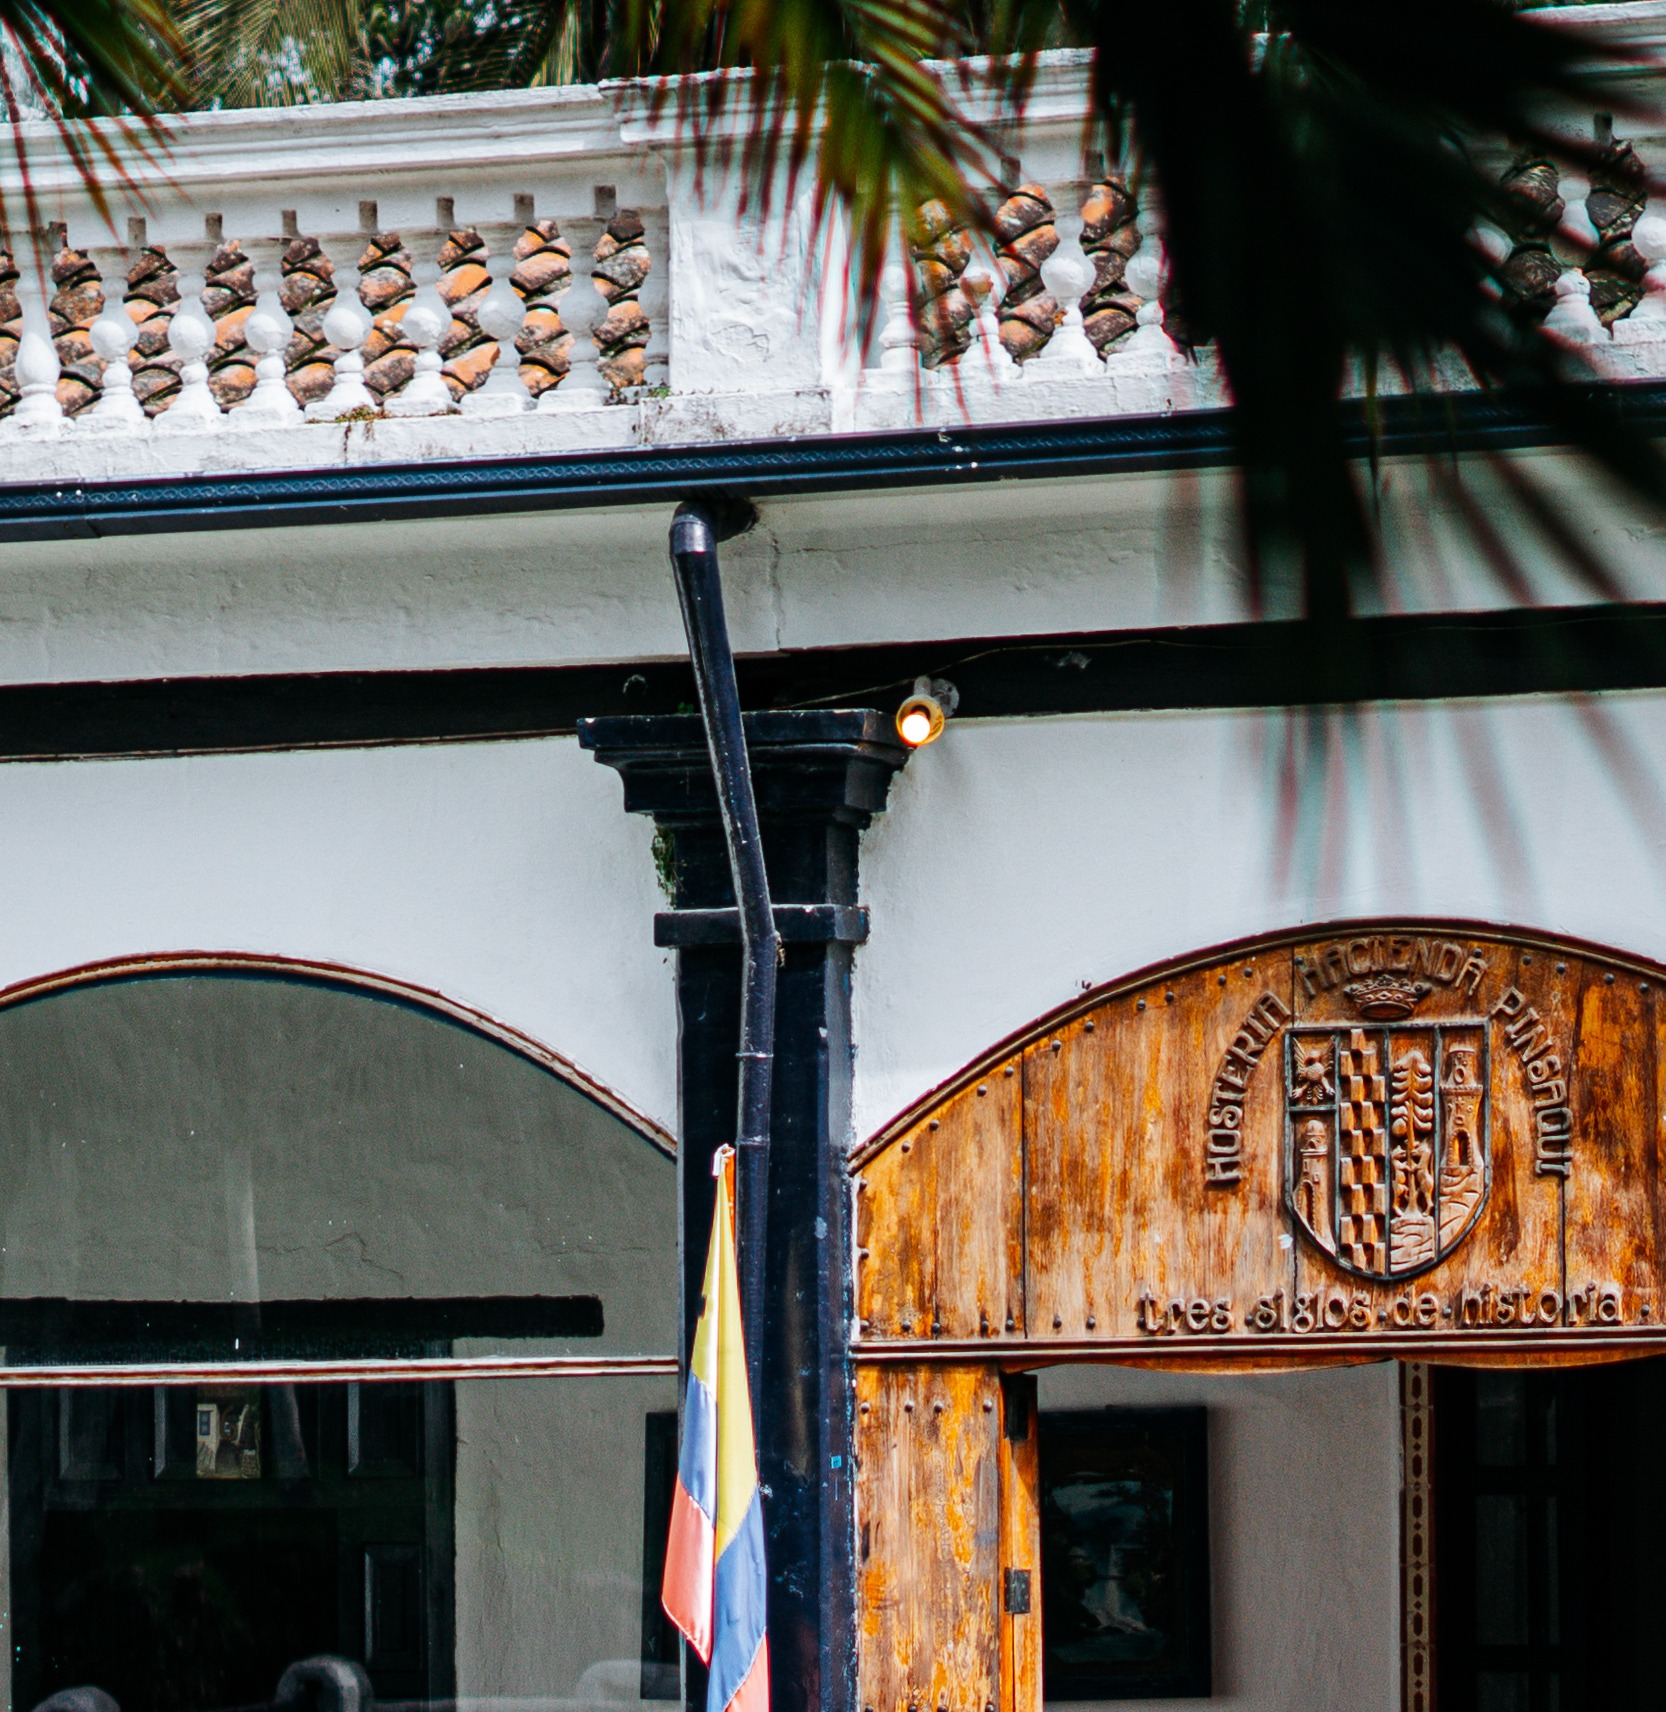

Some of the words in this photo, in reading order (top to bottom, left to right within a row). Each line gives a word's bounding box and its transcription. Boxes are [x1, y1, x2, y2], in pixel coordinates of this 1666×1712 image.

[1206, 990, 1291, 1185] HOSTERIA
[1297, 934, 1487, 998] HACIENDA
[1139, 1287, 1232, 1335] tres
[1253, 1287, 1372, 1334] siglos
[1394, 1285, 1438, 1328] de
[1458, 1281, 1625, 1328] historia
